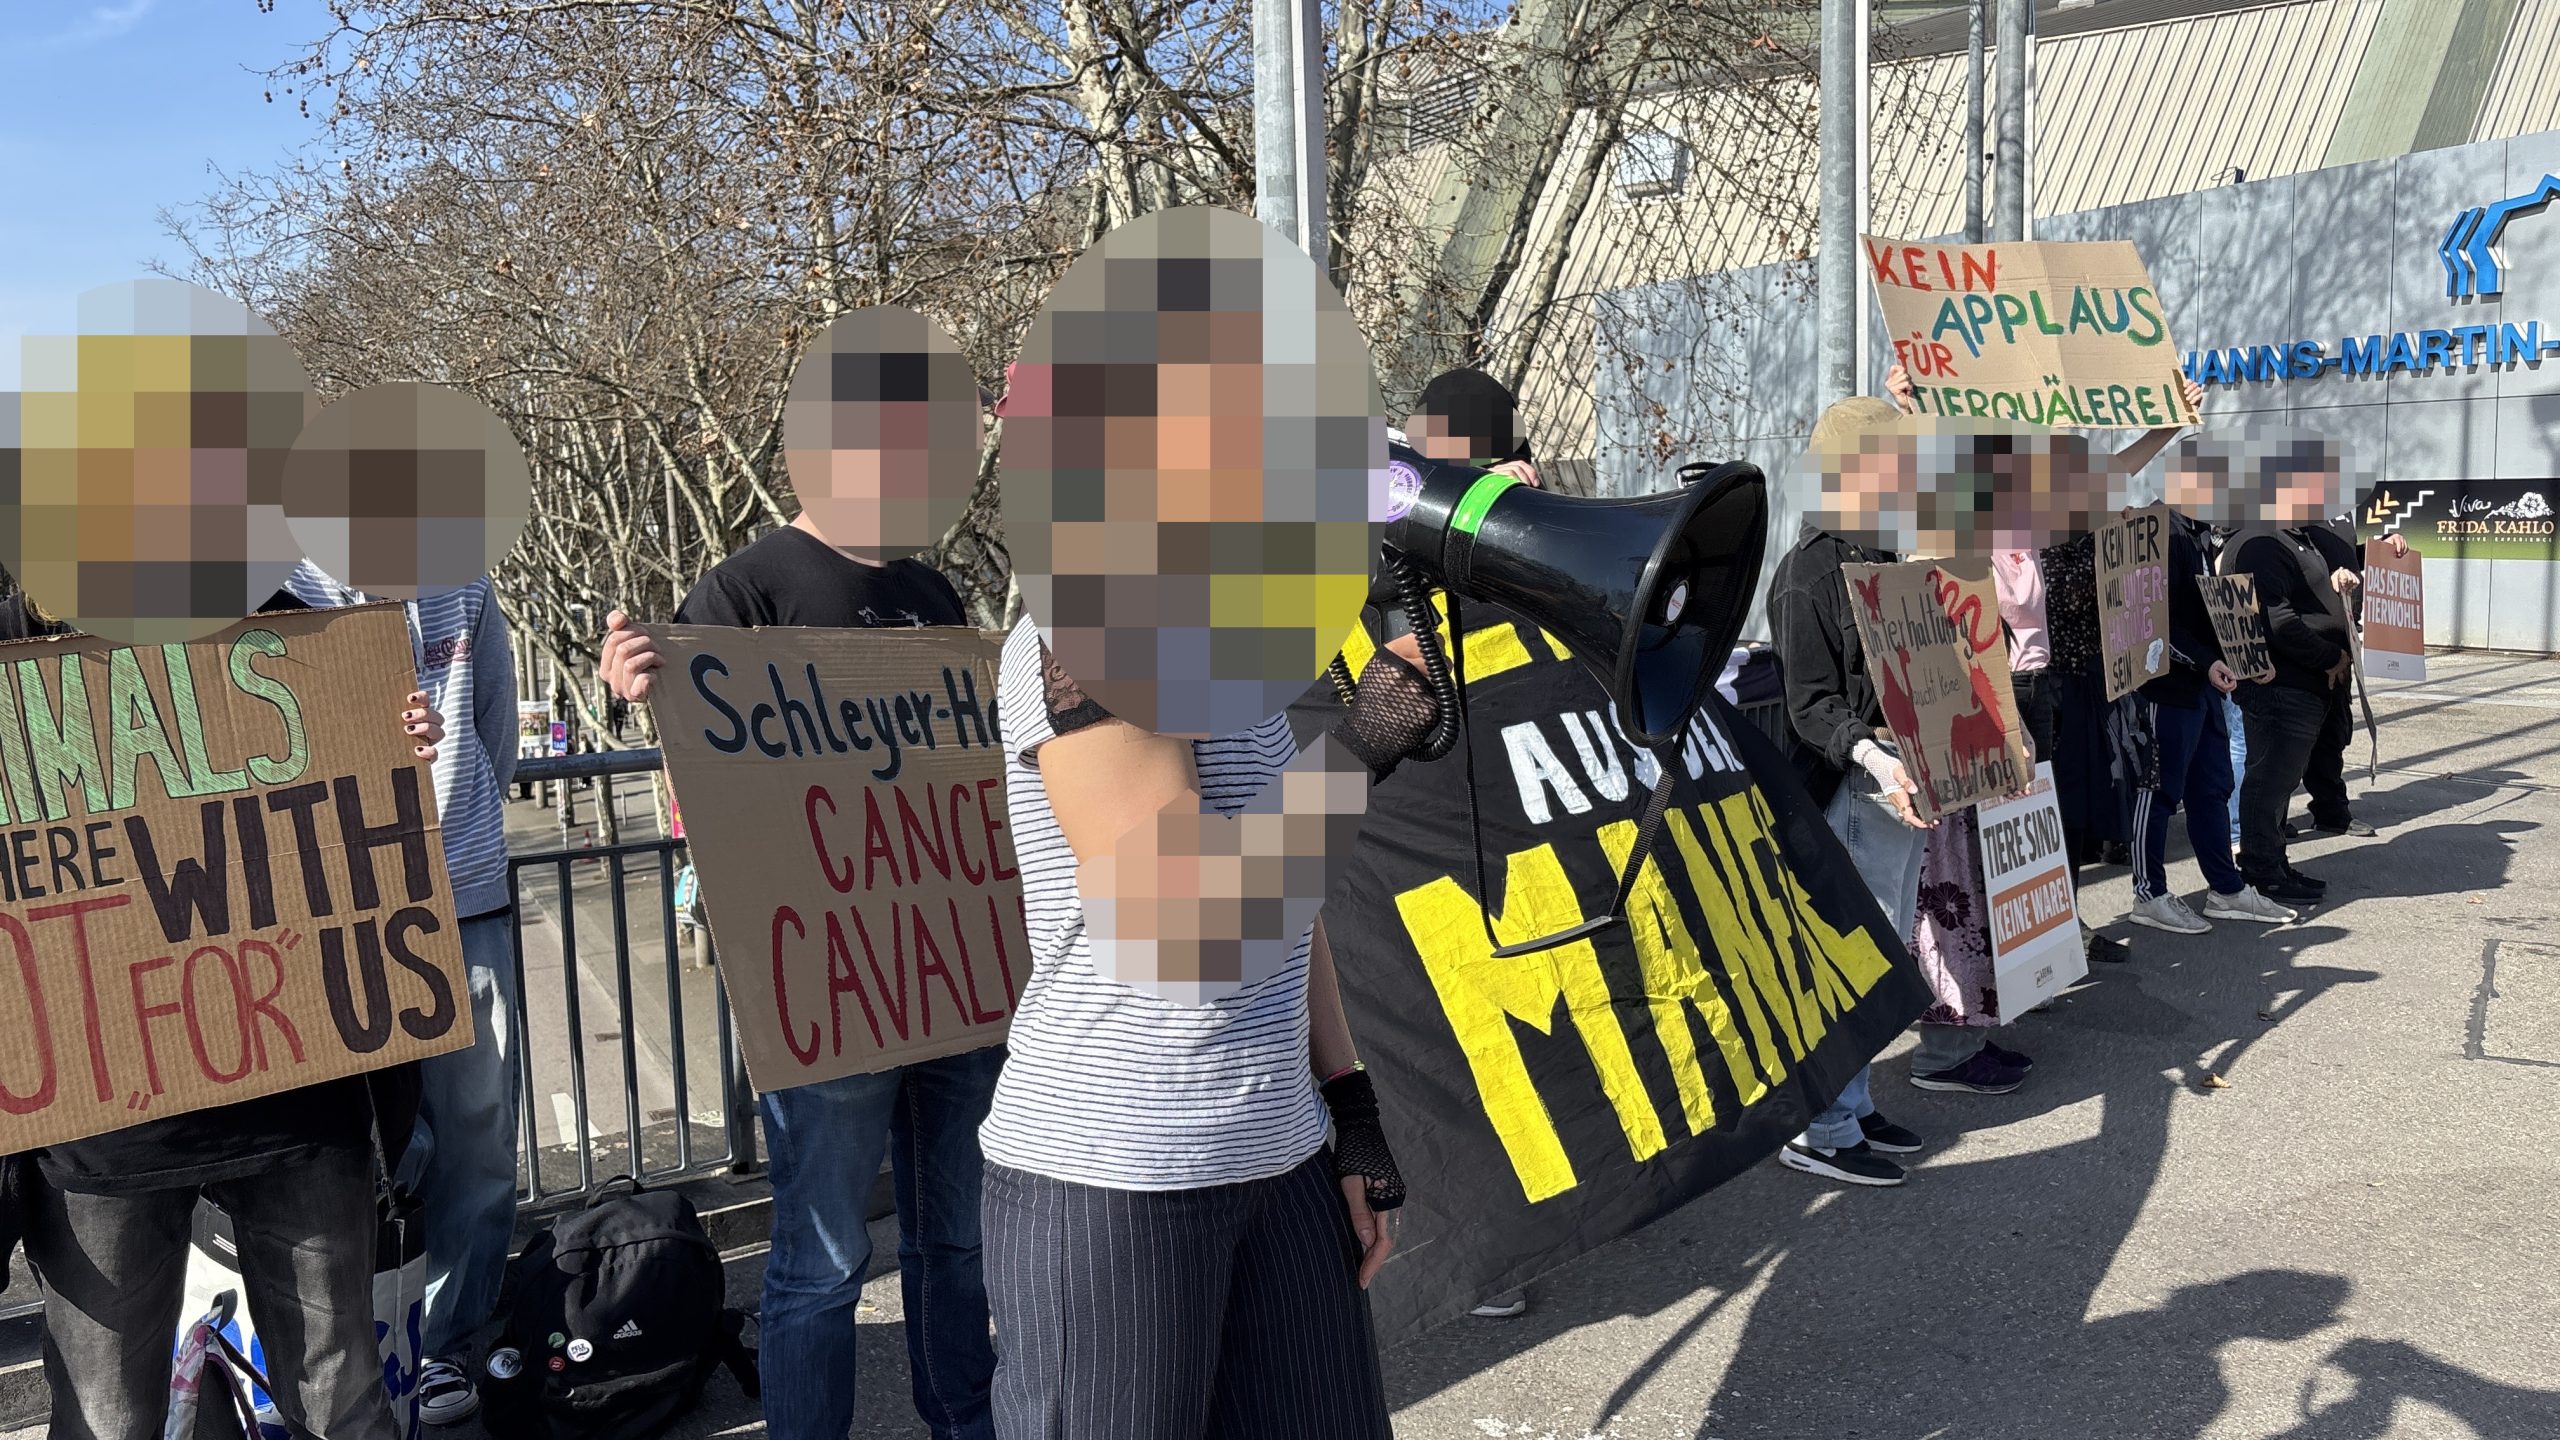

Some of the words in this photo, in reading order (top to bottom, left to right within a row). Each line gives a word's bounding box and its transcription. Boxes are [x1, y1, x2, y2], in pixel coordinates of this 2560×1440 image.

[1867, 239, 1996, 293] KEIN
[1931, 285, 2165, 359] APPLAUS
[1894, 330, 1959, 378] FÜR
[2436, 520, 2490, 534] FRIDA
[2494, 520, 2555, 535] KAHLO
[2448, 494, 2492, 518] Viva
[2101, 524, 2124, 574] KEIN
[2126, 515, 2161, 566] TIER
[2367, 565, 2386, 594] DAS
[2386, 569, 2399, 597] IST
[2399, 573, 2420, 601] KEIN
[1858, 592, 1974, 660] Unterhaltung
[2366, 595, 2421, 630] TIERWOHL!
[2112, 651, 2132, 694] SEIN
[124, 767, 433, 944] WITH
[1983, 816, 2027, 880] TIERE
[2023, 805, 2061, 863] SIND
[1994, 890, 2033, 945] KEINE
[2029, 875, 2070, 925] WARE!
[319, 907, 457, 1054] US
[613, 1329, 643, 1339] adidas
